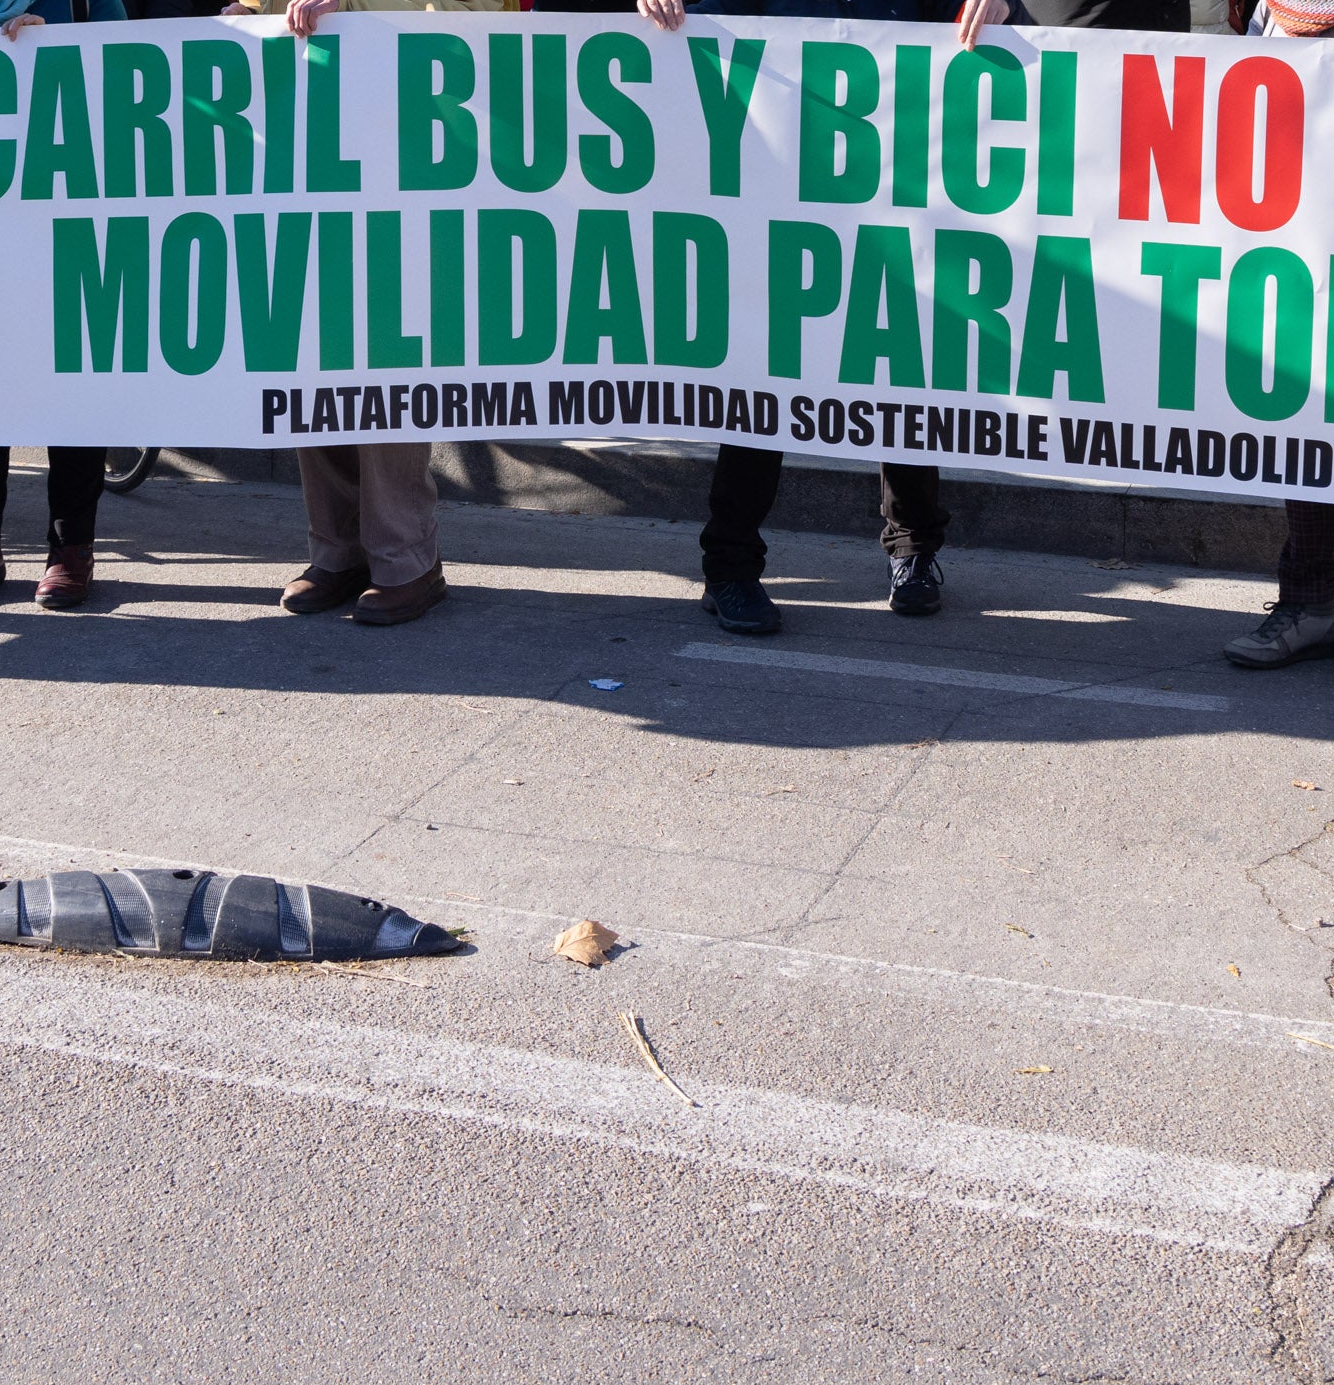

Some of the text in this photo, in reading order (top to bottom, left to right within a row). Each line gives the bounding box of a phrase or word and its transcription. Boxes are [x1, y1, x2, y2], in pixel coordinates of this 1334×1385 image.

[397, 32, 654, 194] BUS
[688, 37, 765, 197] Y
[799, 42, 1077, 216] BICI
[1119, 54, 1304, 232] NO
[53, 209, 729, 375] MOVILIDAD
[769, 220, 1105, 403] PARA
[262, 380, 1333, 488] PLATAFORMA MOVILIDAD SOSTENIBLE VALLADOLID
